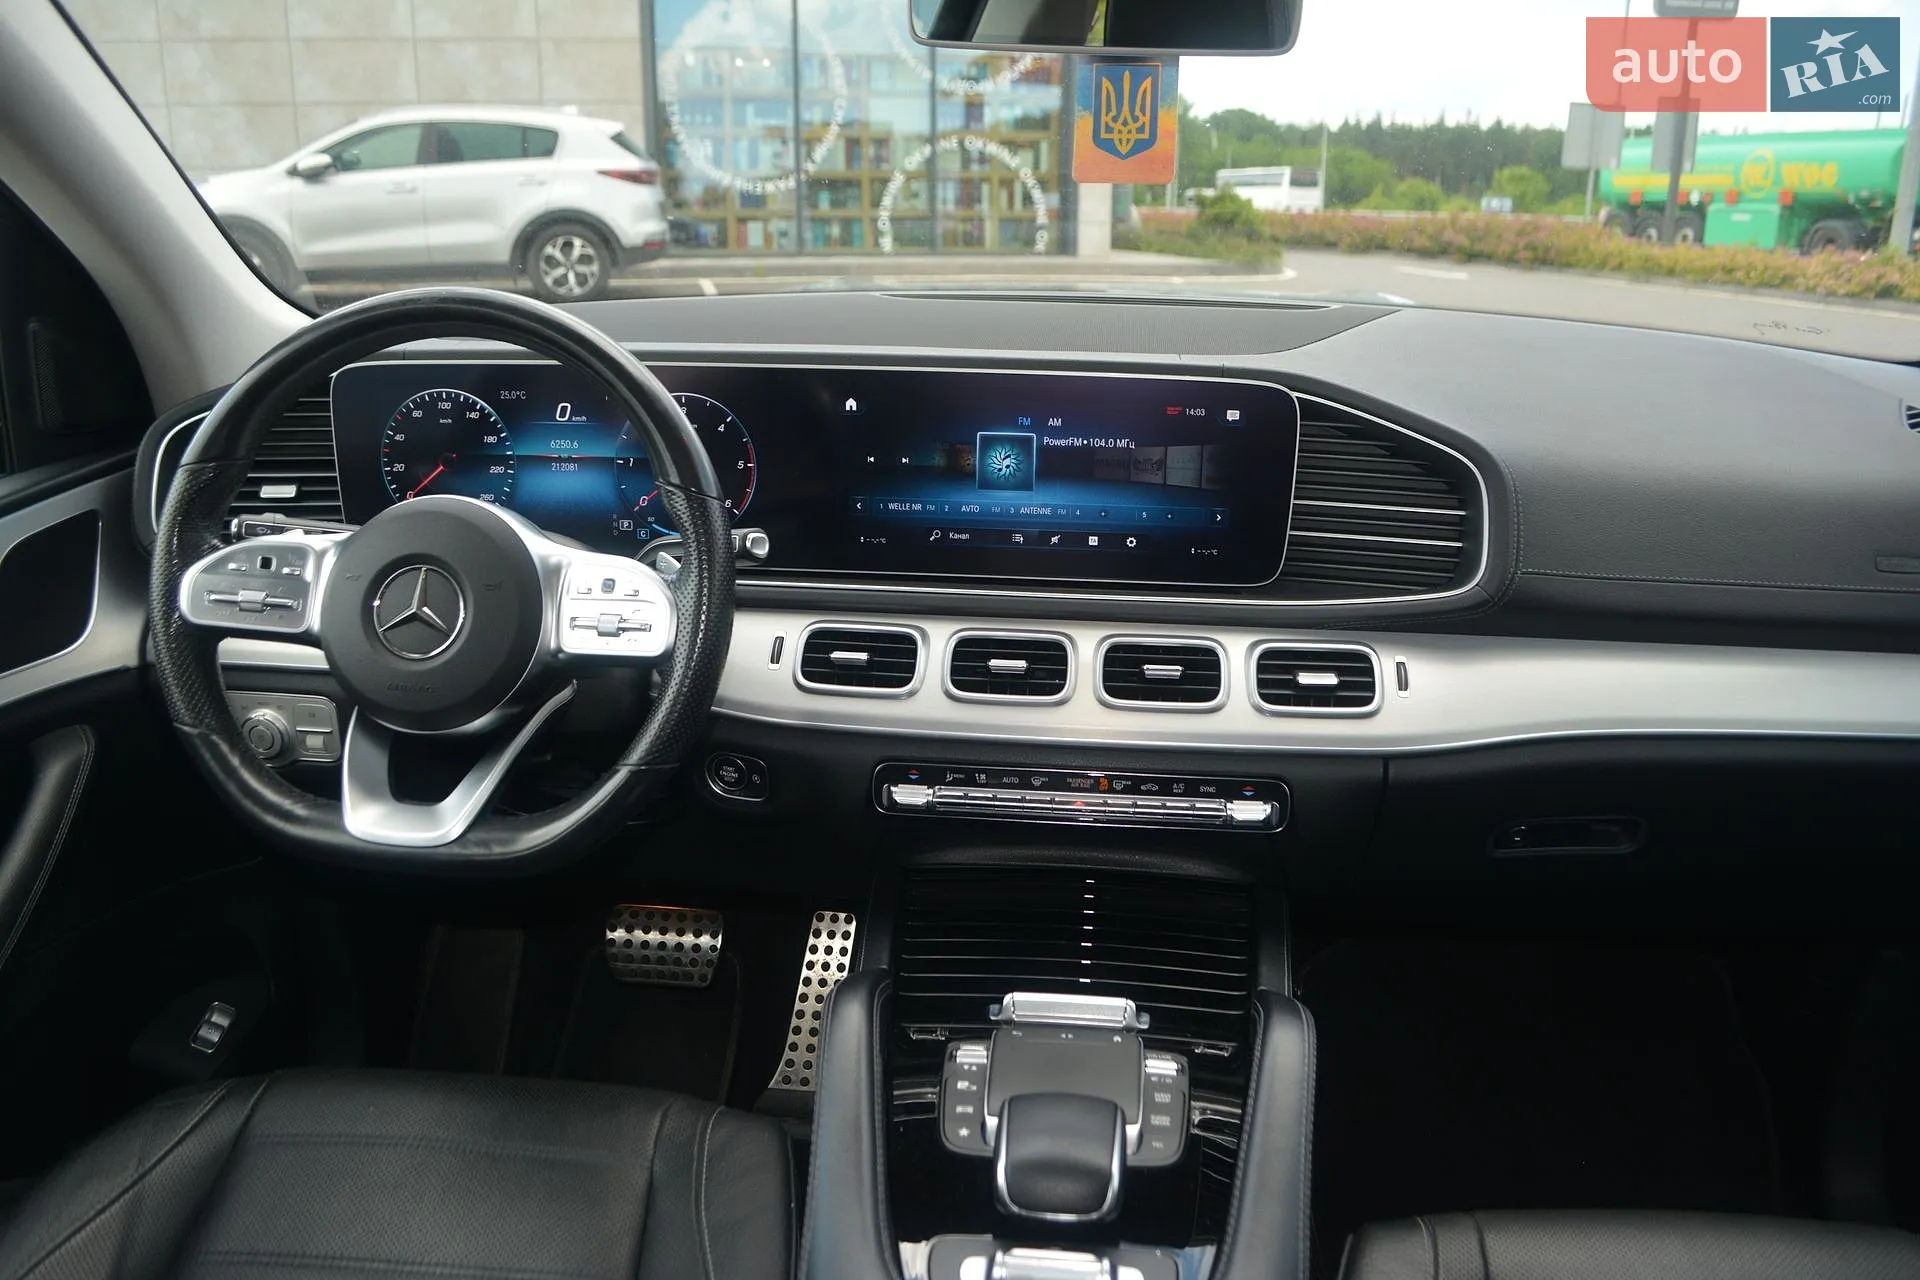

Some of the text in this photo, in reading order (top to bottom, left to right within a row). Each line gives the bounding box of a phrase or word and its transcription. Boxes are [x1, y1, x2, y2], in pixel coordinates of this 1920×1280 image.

[500, 391, 527, 400] 25.0°C
[466, 411, 480, 419] 140
[555, 402, 571, 421] 0
[1185, 408, 1206, 417] 14:03
[1018, 416, 1031, 426] FM
[1048, 417, 1062, 427] AM
[717, 424, 725, 432] 4
[550, 440, 579, 449] 6250.6
[1116, 439, 1136, 450] МГц
[551, 463, 578, 471] 212081
[628, 458, 634, 467] 1
[737, 461, 745, 469] 5
[724, 500, 732, 508] 6
[888, 502, 911, 511] WELLE
[911, 503, 922, 511] NR
[961, 505, 980, 513] AVTO
[1019, 507, 1052, 516] ANTENNE
[1142, 511, 1147, 519] 5
[949, 531, 970, 540] Канал
[1002, 776, 1019, 784] AUTO
[1172, 782, 1185, 790] A/C
[1199, 785, 1216, 793] SYNC
